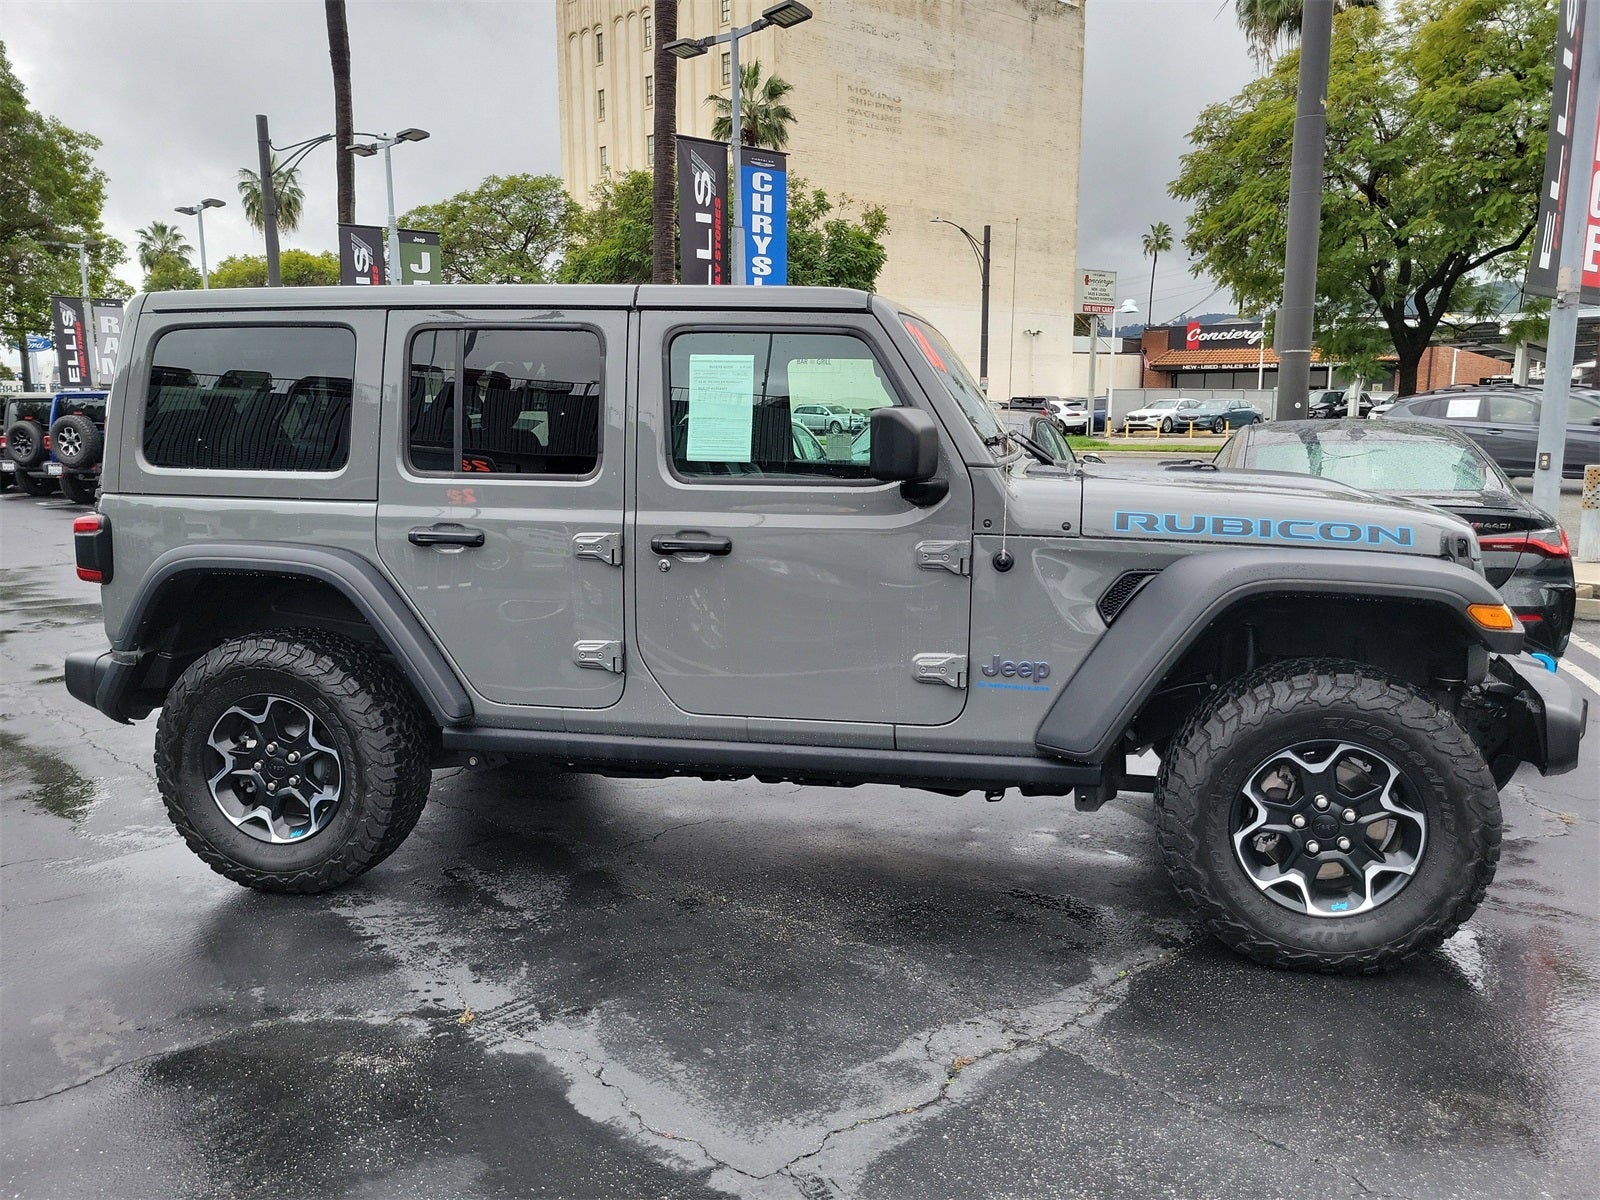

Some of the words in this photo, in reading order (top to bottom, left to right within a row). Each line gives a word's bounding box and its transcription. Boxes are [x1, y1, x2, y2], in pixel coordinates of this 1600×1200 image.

[847, 85, 902, 103] MOVING
[847, 96, 902, 113] SHIPPING
[847, 108, 902, 124] PACKING
[412, 236, 426, 244] Jeep
[694, 170, 712, 285] LIS
[714, 197, 722, 261] STORES
[752, 172, 773, 285] CHRYS
[62, 309, 81, 383] ELLIS
[1186, 328, 1264, 345] Concierg
[1114, 511, 1415, 547] RUBICON
[981, 653, 1051, 684] Jeep
